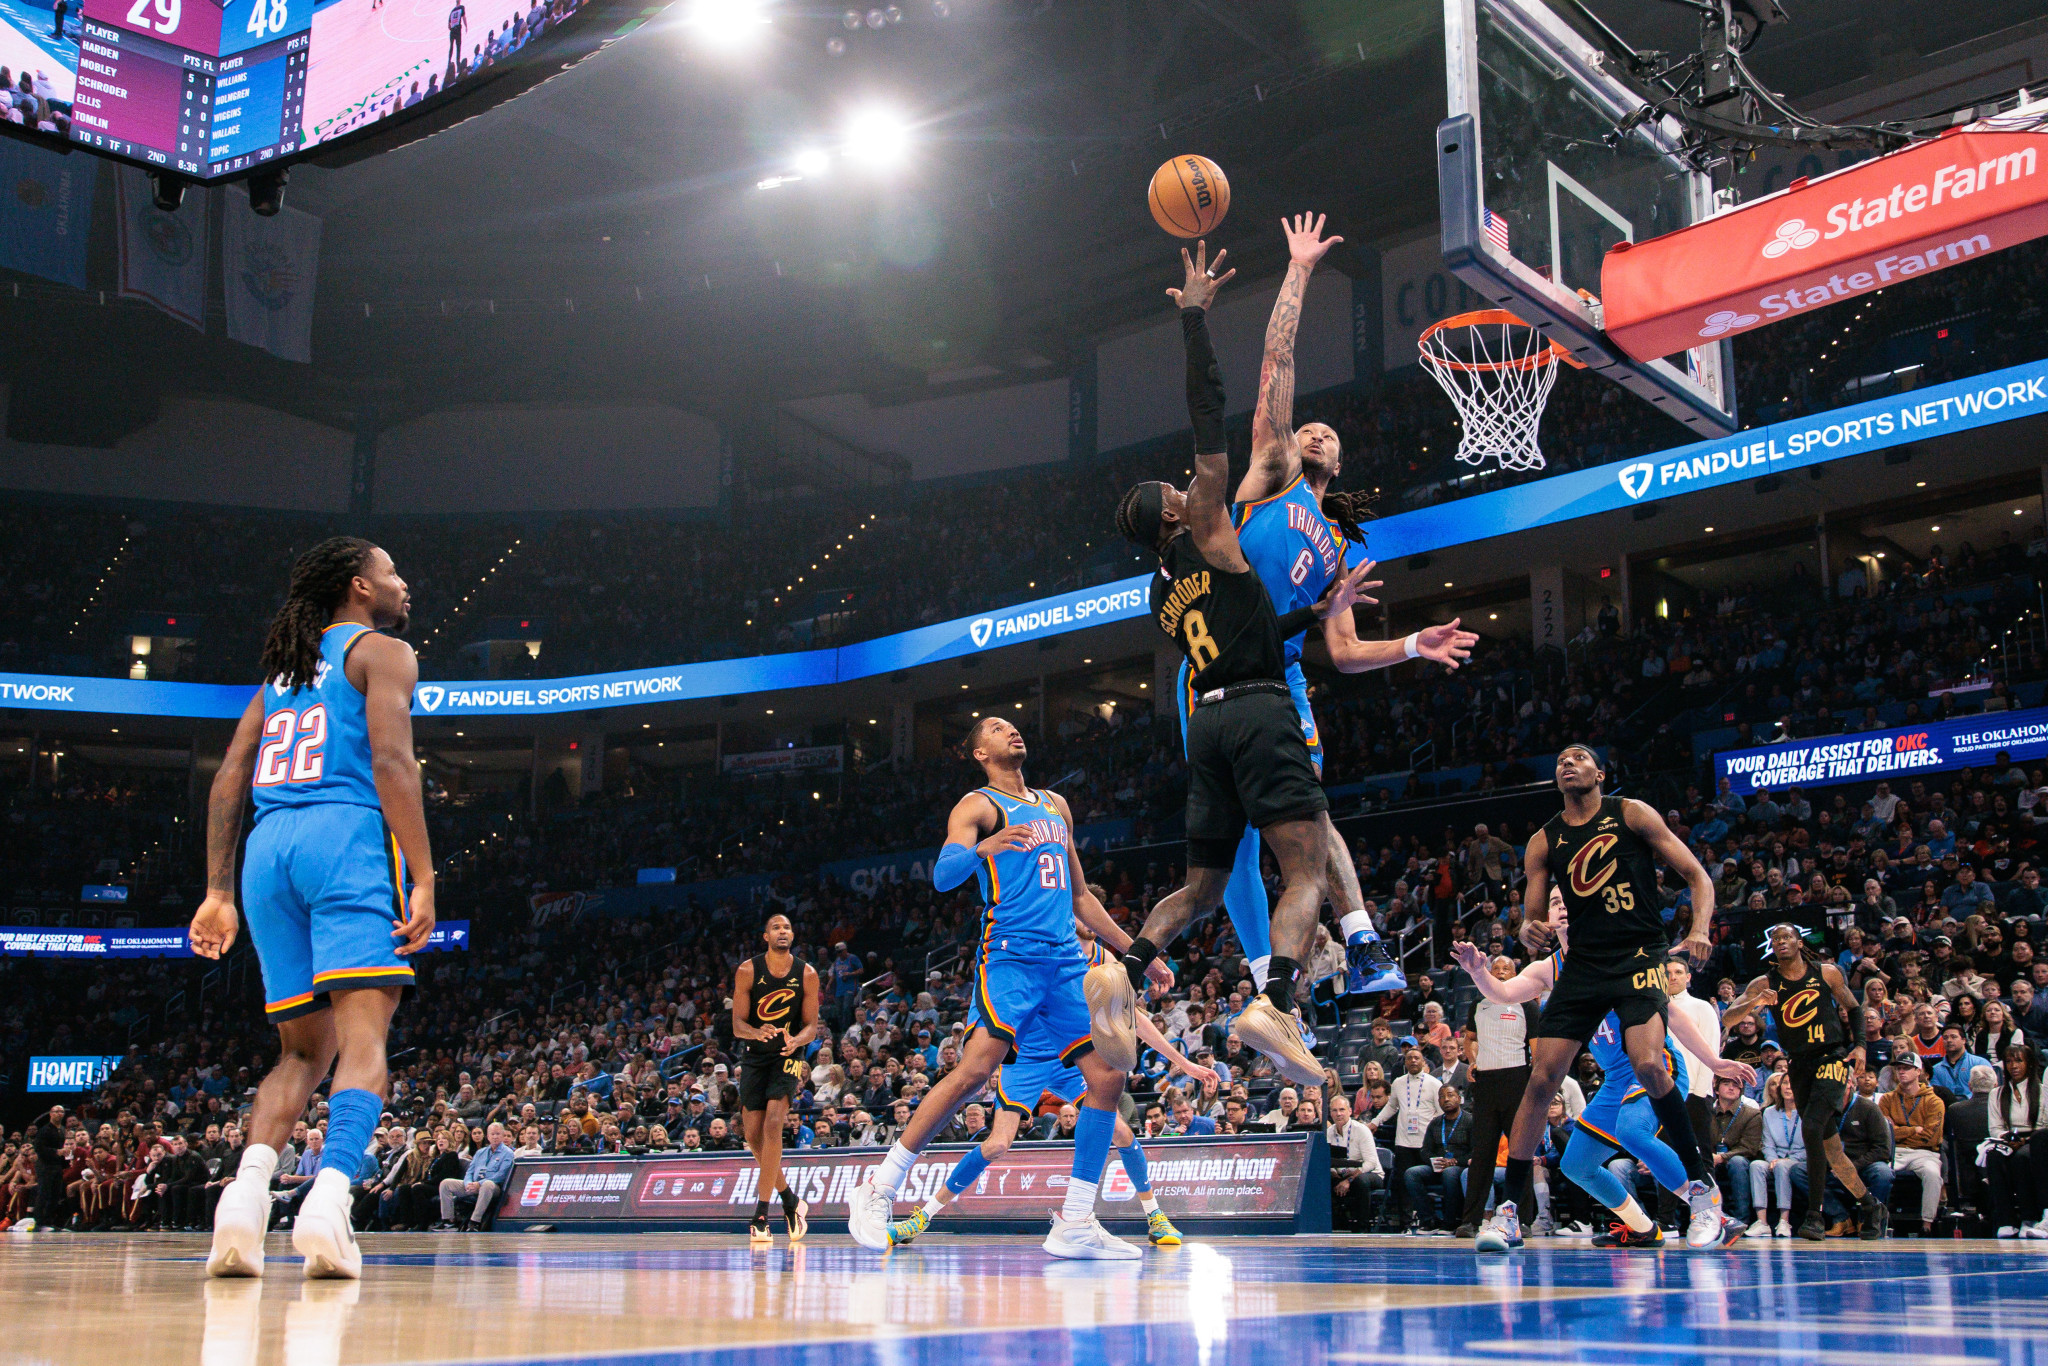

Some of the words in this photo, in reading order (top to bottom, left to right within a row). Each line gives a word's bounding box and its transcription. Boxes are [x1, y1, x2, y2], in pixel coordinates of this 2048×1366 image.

[126, 0, 182, 35] 29
[246, 0, 288, 38] 48
[82, 40, 119, 60] HARDEN
[188, 73, 195, 83] 5
[85, 23, 120, 43] PLAYER
[183, 54, 201, 68] PTS
[203, 60, 215, 72] FL
[220, 57, 244, 72] PLAYER
[287, 38, 299, 51] PTS
[300, 35, 309, 46] FL
[80, 58, 118, 77] MOBLEY
[186, 90, 193, 100] 0
[201, 94, 209, 104] 0
[215, 88, 250, 106] HOLMGREN
[298, 70, 304, 80] 0
[217, 72, 248, 88] WILLIAMS
[300, 52, 306, 62] 0
[76, 93, 102, 109] ELLIS
[183, 125, 190, 135] 0
[198, 129, 205, 139] 0
[78, 75, 128, 99] SCHRODER
[184, 108, 191, 117] 4
[200, 112, 207, 122] 0
[213, 107, 242, 123] WIGGINS
[286, 91, 291, 101] 5
[296, 87, 302, 97] 0
[314, 58, 430, 135] paycom
[319, 85, 405, 144] center
[74, 110, 109, 129] TOMLIN
[181, 142, 188, 152] 0
[210, 144, 230, 157] TOPIC
[283, 126, 288, 136] 2
[293, 122, 299, 132] 2
[212, 124, 241, 140] WALLACE
[284, 108, 290, 118] 5
[295, 105, 300, 115] 0
[79, 130, 91, 142] TO
[95, 135, 102, 146] 5
[109, 139, 121, 151] TF
[147, 150, 166, 164] 2ND
[178, 160, 198, 173] 8:36
[213, 163, 222, 174] TO
[224, 161, 230, 171] 6
[234, 158, 243, 169] TF
[260, 148, 273, 160] 2ND
[280, 141, 295, 154] 8:36
[56, 170, 72, 236] OKLAHOMA
[1185, 158, 1212, 209] Wilson
[1660, 439, 1784, 486] FANDUEL
[1787, 413, 1894, 456] SPORTS
[1901, 376, 2047, 431] NETWORK
[1285, 502, 1338, 578] THUNDER
[1288, 547, 1315, 587] 6
[996, 605, 1073, 638] FANDUEL
[1075, 589, 1141, 620] SPORTS
[1160, 570, 1211, 637] SCHRÖDER
[1183, 609, 1221, 673] 8
[448, 690, 535, 706] FANDUEL
[537, 684, 600, 704] SPORTS
[602, 675, 683, 699] NETWORK
[252, 702, 328, 787] 22
[1726, 753, 1765, 775] YOUR
[1767, 748, 1810, 769] DAILY
[1810, 741, 1861, 763] ASSIST
[1862, 737, 1893, 757] FOR
[1895, 732, 1928, 752] OKC
[1952, 733, 1980, 746] THE
[1953, 745, 1974, 754] PROUD
[1974, 741, 2001, 751] PARTNER
[2011, 735, 2046, 746] OKLAHOMA
[1751, 763, 1826, 788] COVERAGE
[1828, 757, 1866, 778] THAT
[1866, 747, 1943, 773] DELIVERS.
[1038, 852, 1067, 890] 21
[1567, 833, 1619, 898] C
[1602, 881, 1635, 914] 35
[4, 941, 47, 951] COVERAGE
[47, 942, 68, 951] THAT
[67, 943, 107, 952] DELIVERS.
[15, 933, 40, 942] DAILY
[38, 934, 68, 943] ASSIST
[67, 934, 84, 943] FOR
[84, 935, 102, 944] OKC
[127, 937, 173, 945] OKLAHOMAN
[757, 988, 796, 1021] C
[1781, 988, 1820, 1028] C
[1807, 1024, 1825, 1043] 14
[549, 1173, 607, 1191] DOWNLOAD
[604, 1172, 633, 1191] NOW
[728, 1165, 831, 1205] ALAYS
[825, 1164, 863, 1204] IN
[1147, 1158, 1234, 1182] DOWNLOAD
[1234, 1157, 1277, 1181] NOW
[544, 1194, 553, 1202] All
[1153, 1184, 1164, 1196] of
[1164, 1185, 1191, 1196] ESPN.
[1194, 1184, 1205, 1195] All
[1206, 1185, 1216, 1195] in
[1217, 1187, 1235, 1195] one
[1235, 1184, 1264, 1197] place.
